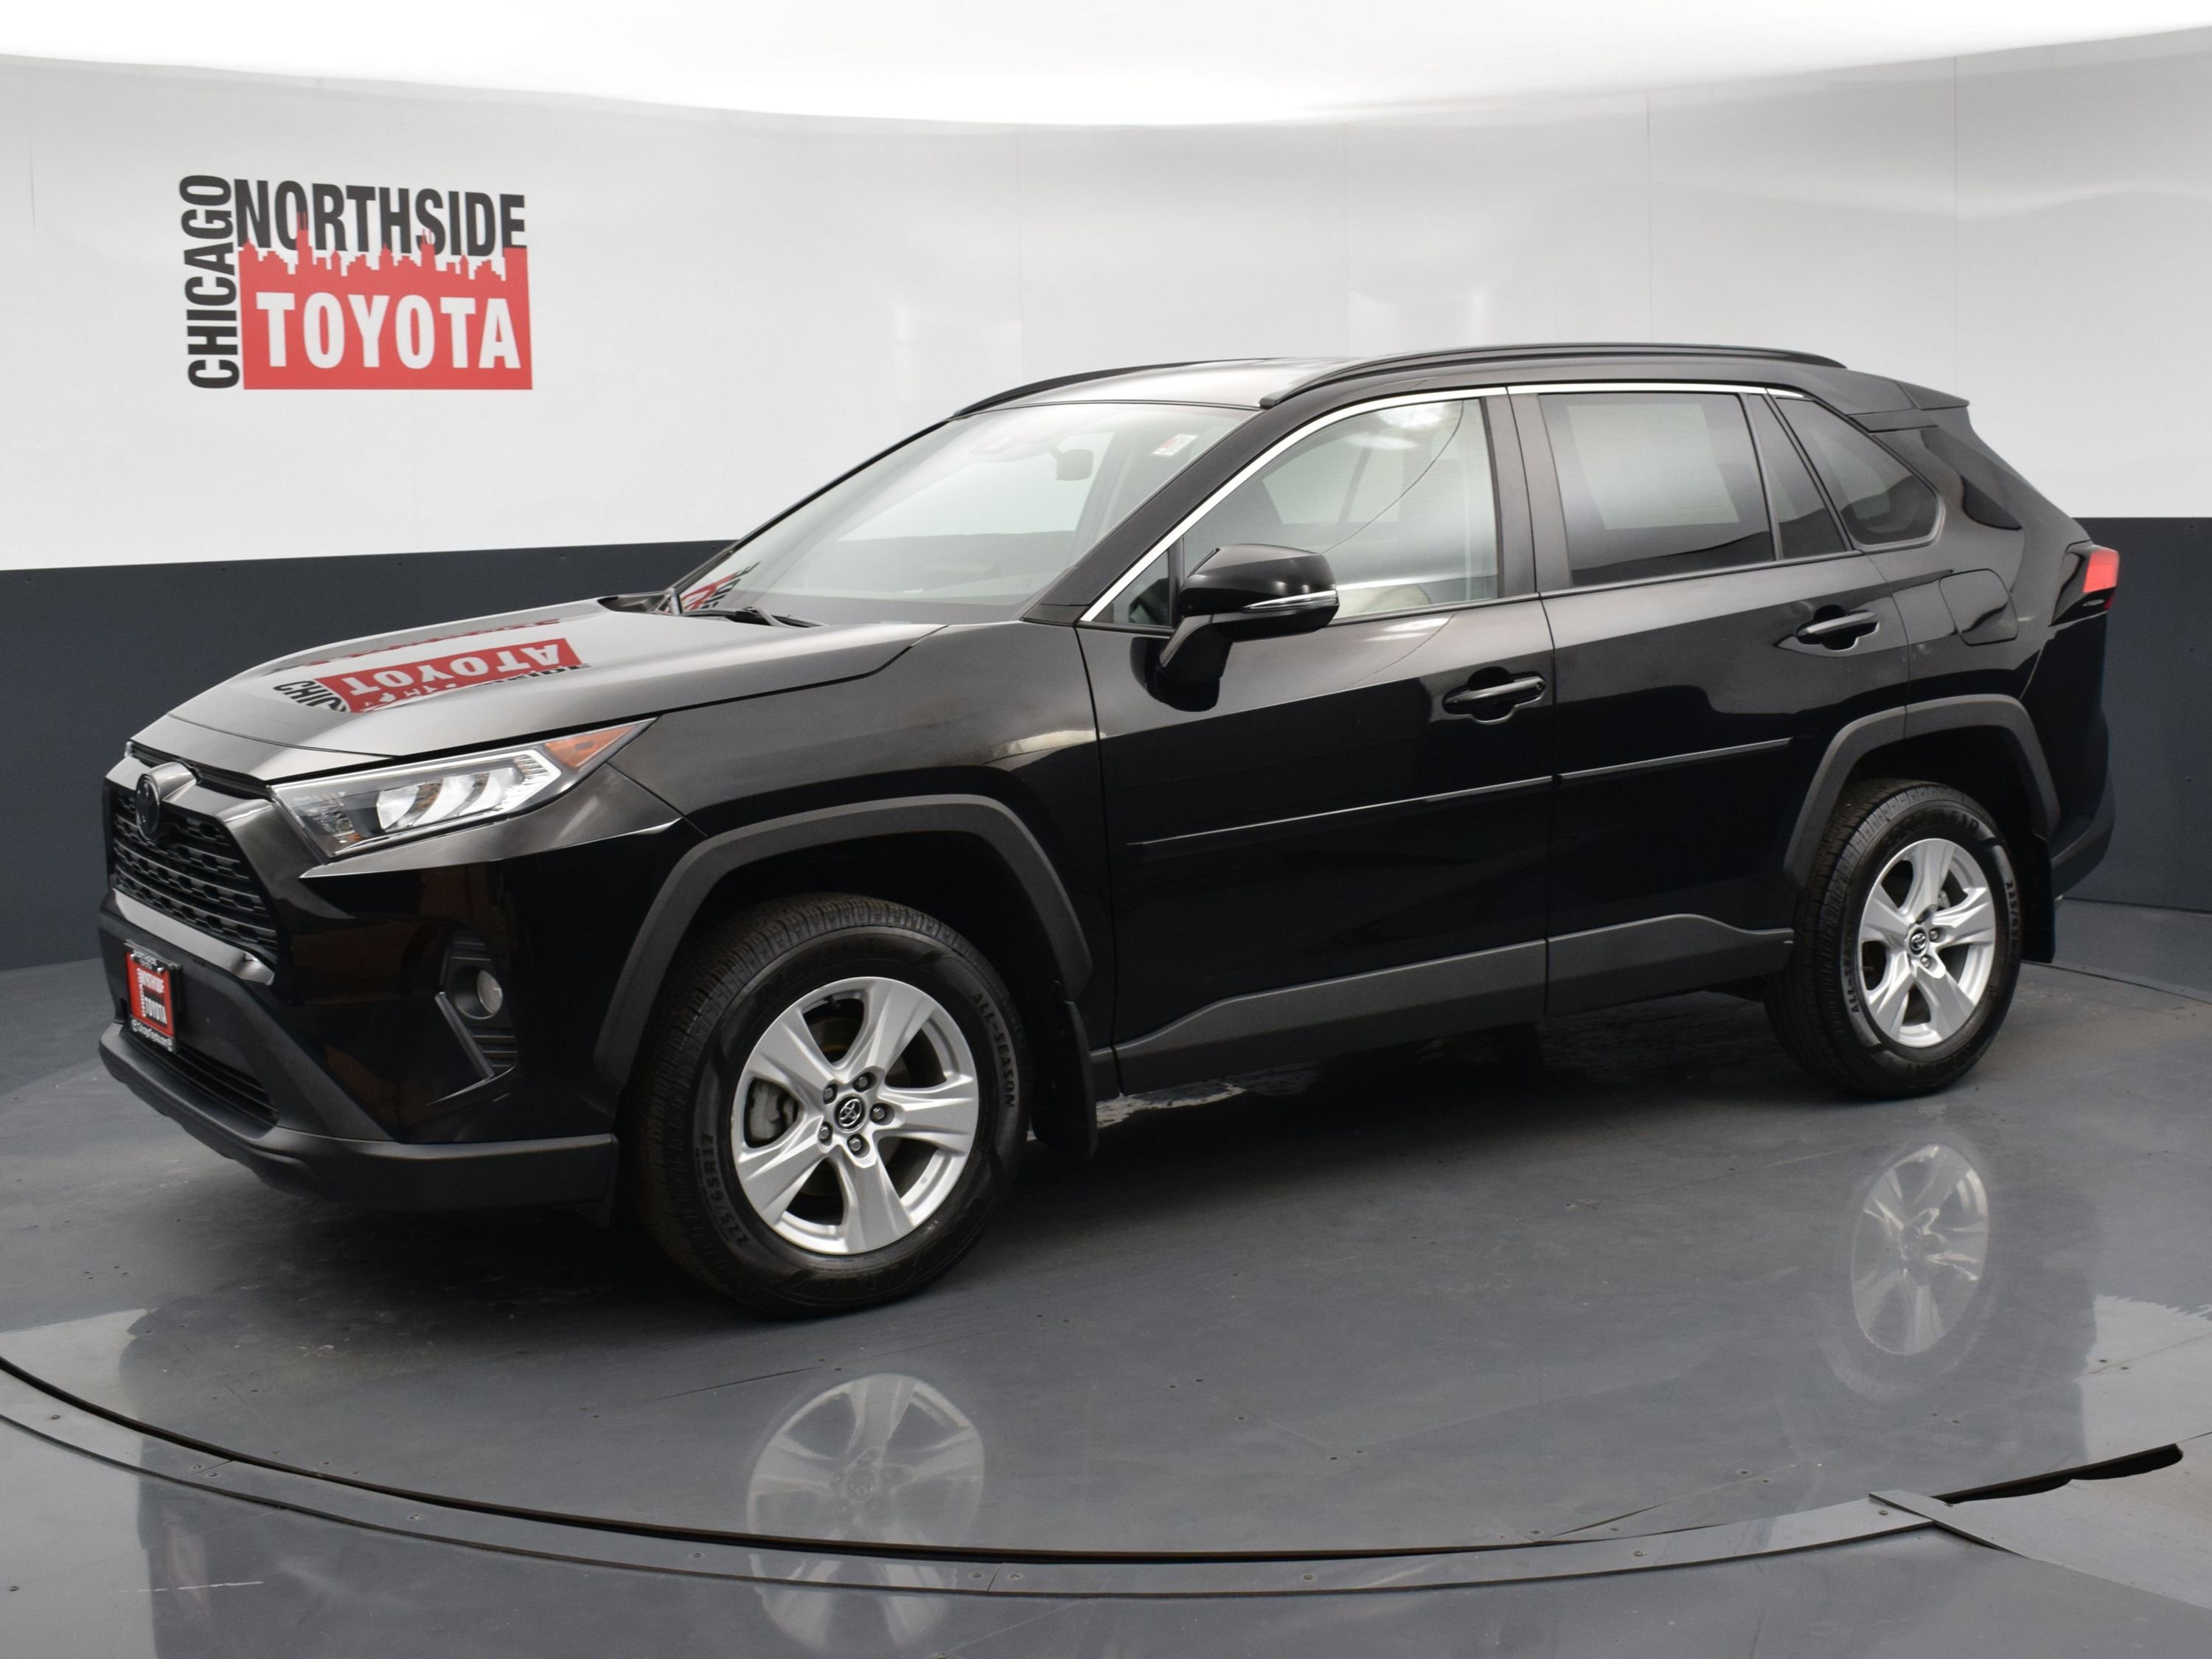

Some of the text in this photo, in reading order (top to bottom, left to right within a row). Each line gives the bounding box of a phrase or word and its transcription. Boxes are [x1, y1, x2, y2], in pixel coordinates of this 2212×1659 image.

[234, 178, 527, 257] NORTHSIDE
[179, 175, 240, 389] CHICAGO
[256, 292, 521, 369] TOYOTA
[973, 992, 1016, 1108] ALL-SEASON
[701, 1133, 750, 1248] 225/65R17
